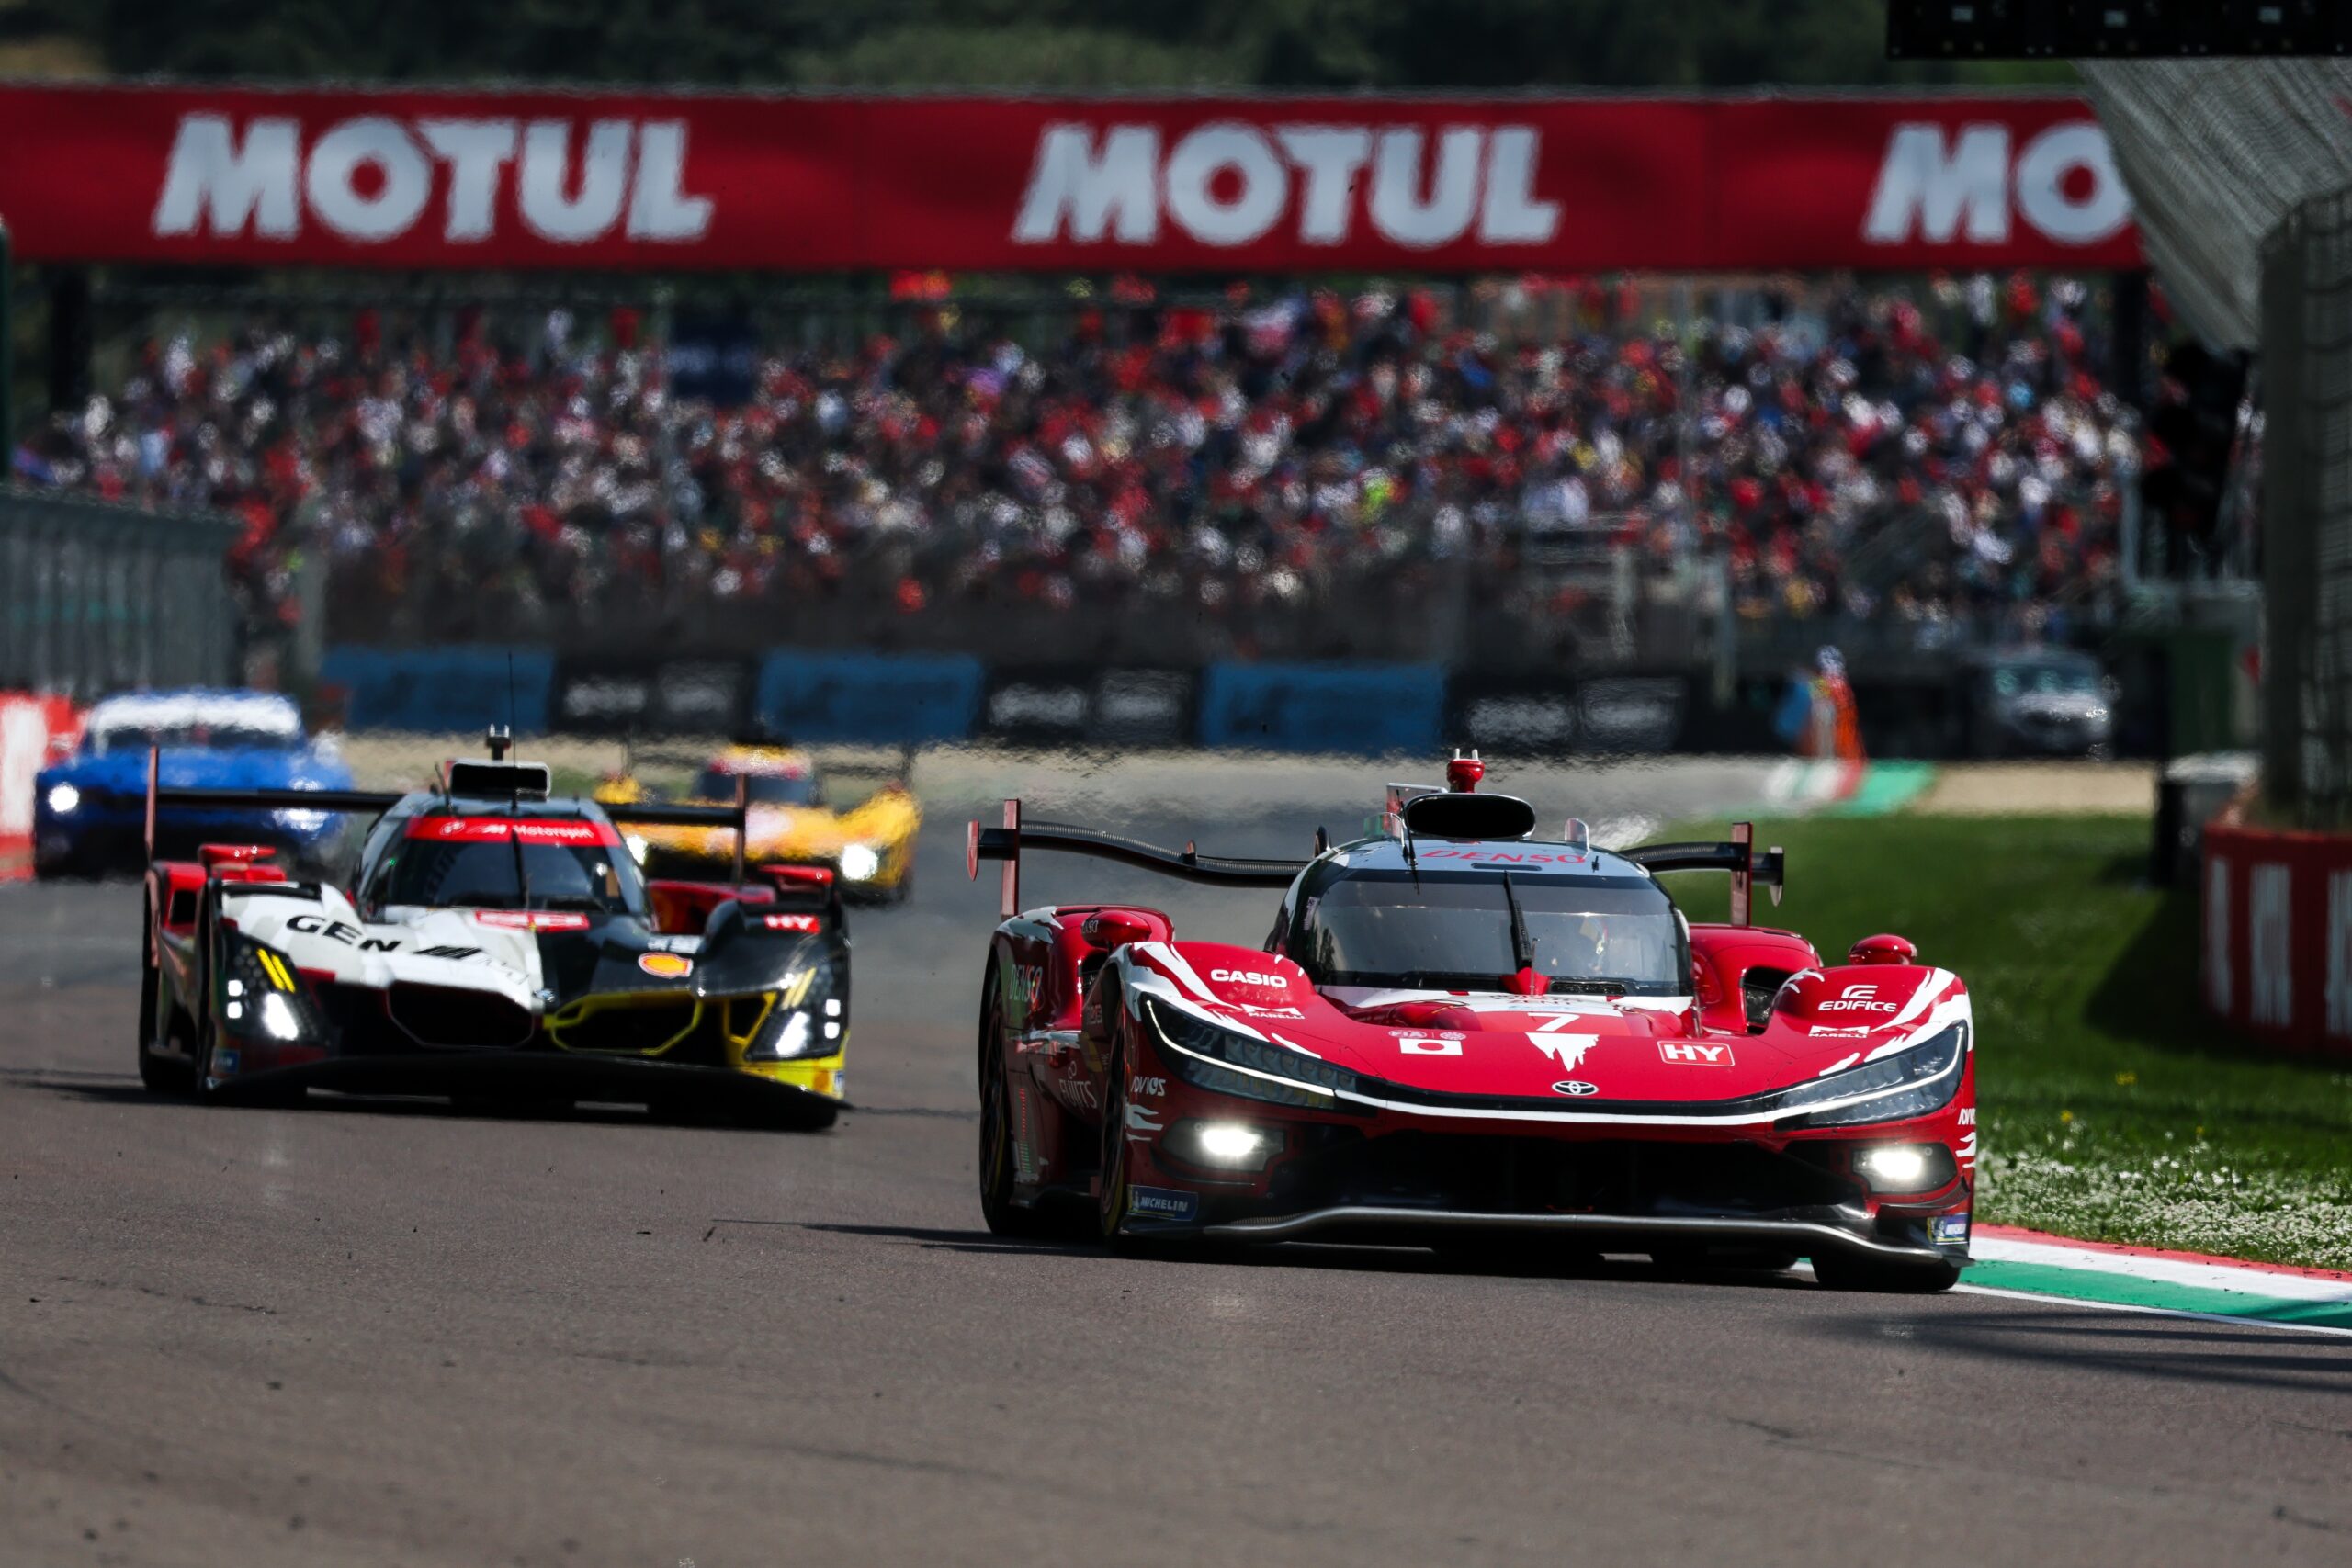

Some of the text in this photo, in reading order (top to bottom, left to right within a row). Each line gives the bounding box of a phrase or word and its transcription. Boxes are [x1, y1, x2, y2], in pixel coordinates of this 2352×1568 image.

[153, 111, 714, 244] MOTUL
[1013, 118, 1562, 250] MOTUL
[513, 824, 594, 839] Motorsport
[1421, 850, 1586, 863] DENSO
[286, 915, 402, 952] GEN
[1008, 964, 1043, 1003] DENSO
[1211, 969, 1287, 988] CASIO
[1818, 1000, 1897, 1012] EDIFICE
[1527, 1012, 1580, 1032] 7
[1664, 1044, 1724, 1061] HY
[1058, 1078, 1098, 1114] FUJITS
[1140, 1196, 1189, 1212] MICHELIN
